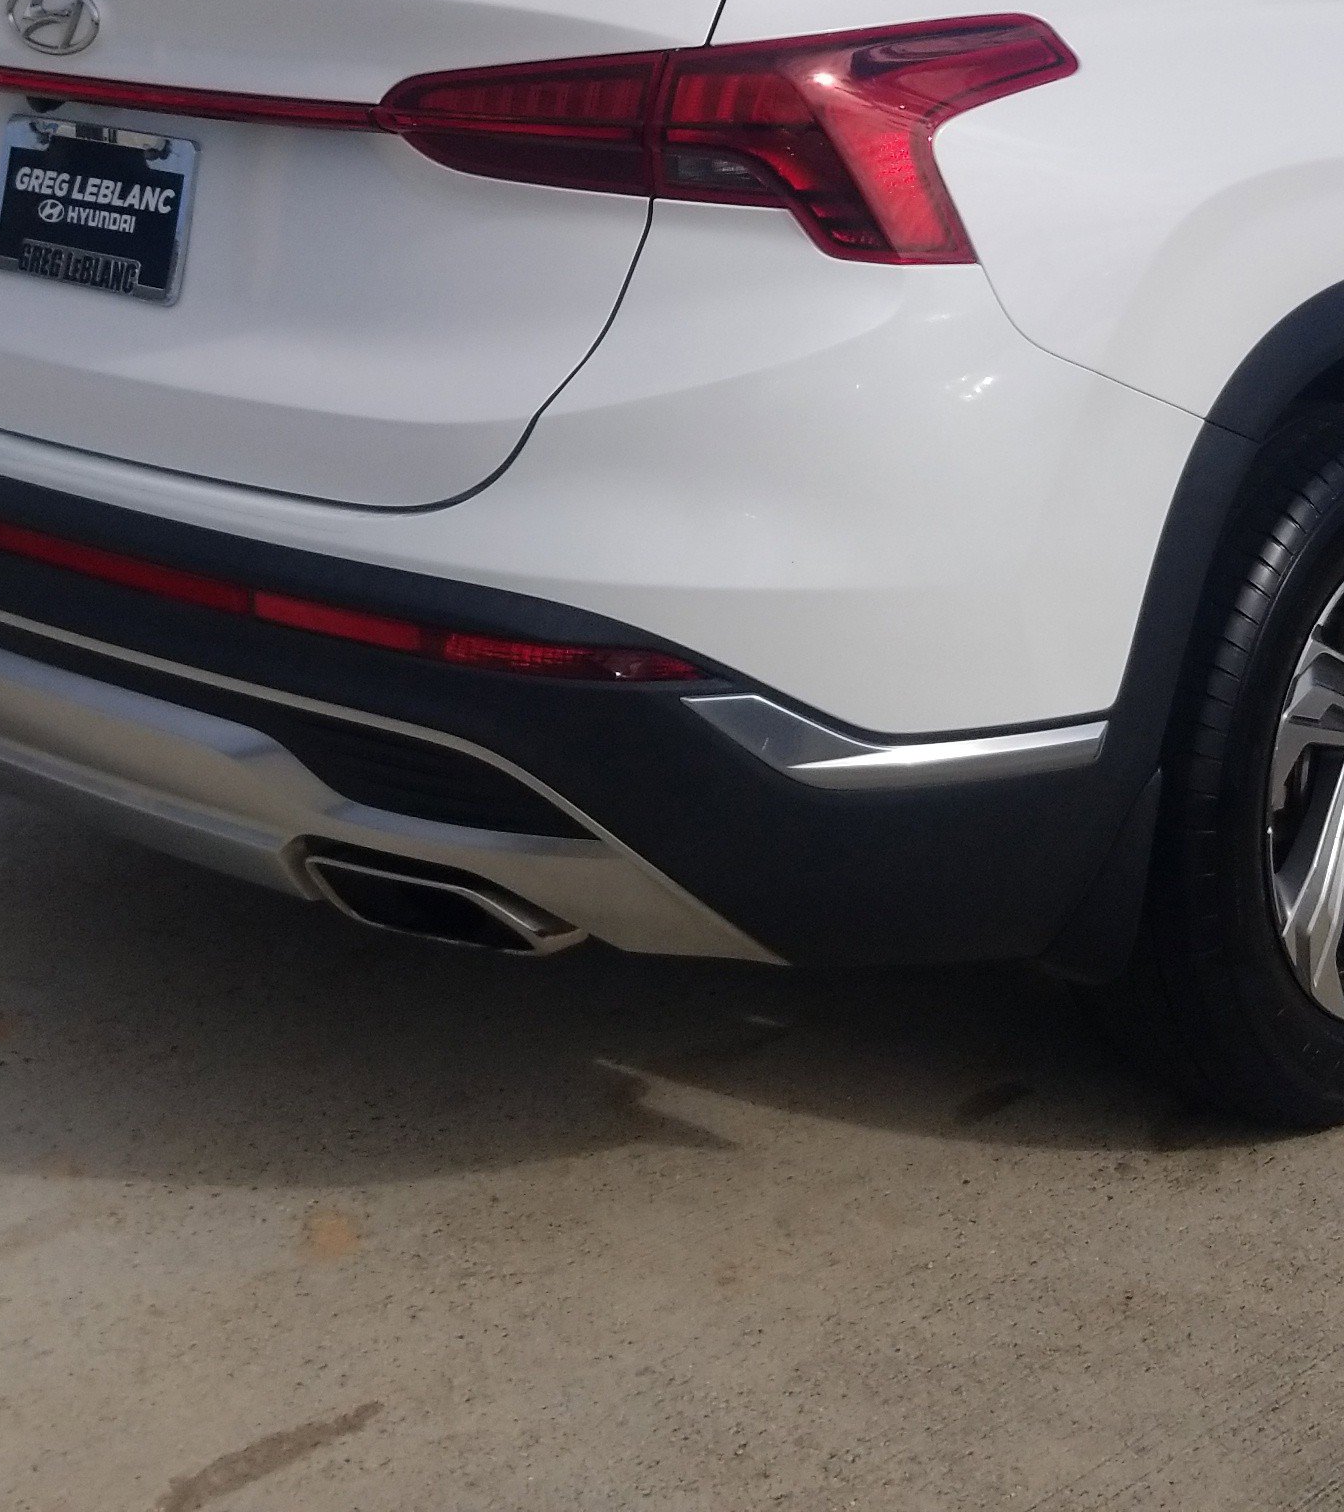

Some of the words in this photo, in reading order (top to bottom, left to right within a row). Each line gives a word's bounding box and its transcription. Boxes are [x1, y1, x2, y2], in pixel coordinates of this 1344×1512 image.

[15, 166, 70, 197] GREG
[71, 175, 176, 214] LEBLANC
[66, 205, 137, 234] HYUNDAI
[18, 243, 63, 277] GREG
